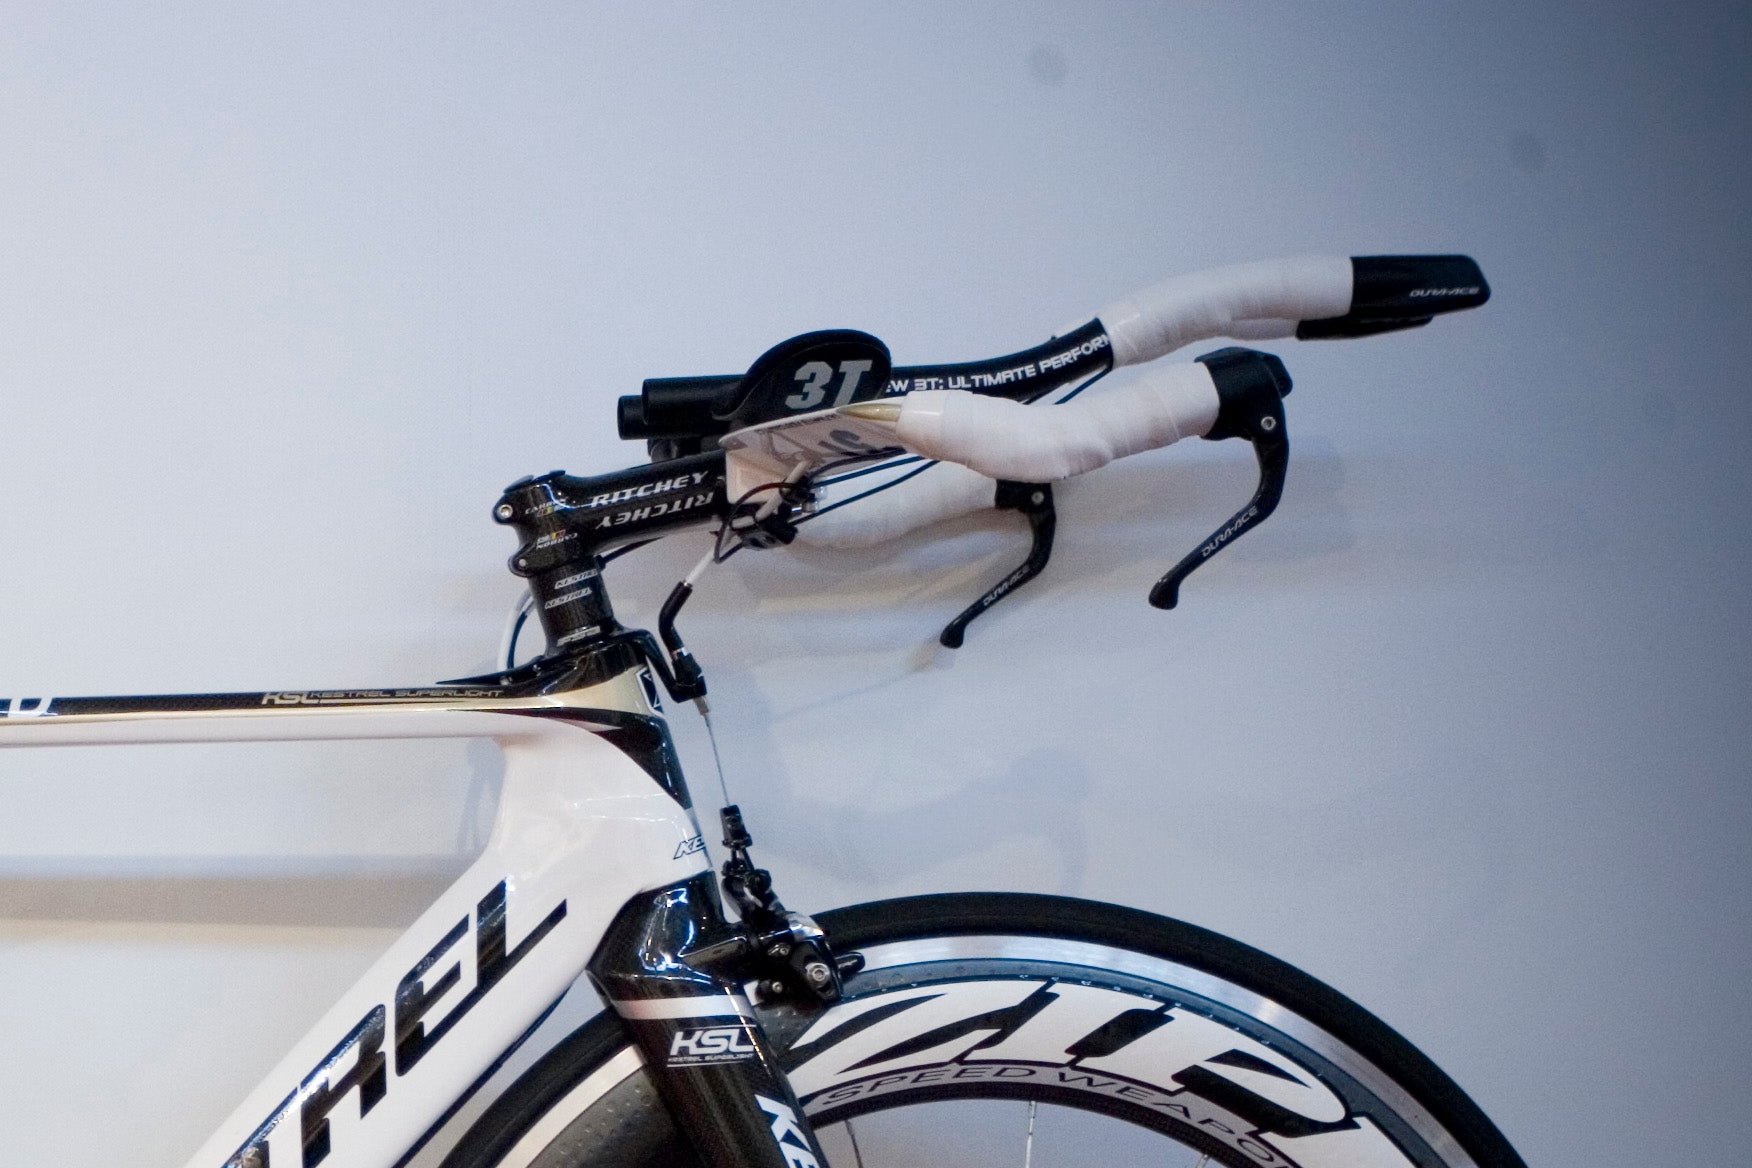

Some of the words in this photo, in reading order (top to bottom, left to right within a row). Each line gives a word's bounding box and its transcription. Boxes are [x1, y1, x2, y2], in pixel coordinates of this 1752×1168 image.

[785, 361, 873, 409] 3T
[948, 363, 1037, 389] ULTIMATE
[591, 470, 709, 508] RITCHEY
[595, 492, 714, 529] RITCHEY
[1201, 506, 1258, 557] DURA-ACE
[983, 564, 1030, 606] DURA-ACE
[261, 691, 321, 705] KSL
[311, 690, 391, 699] KESTREL
[395, 689, 504, 699] SUPERLIGHT
[669, 1028, 755, 1056] KSL
[822, 1065, 1037, 1106] SPEED
